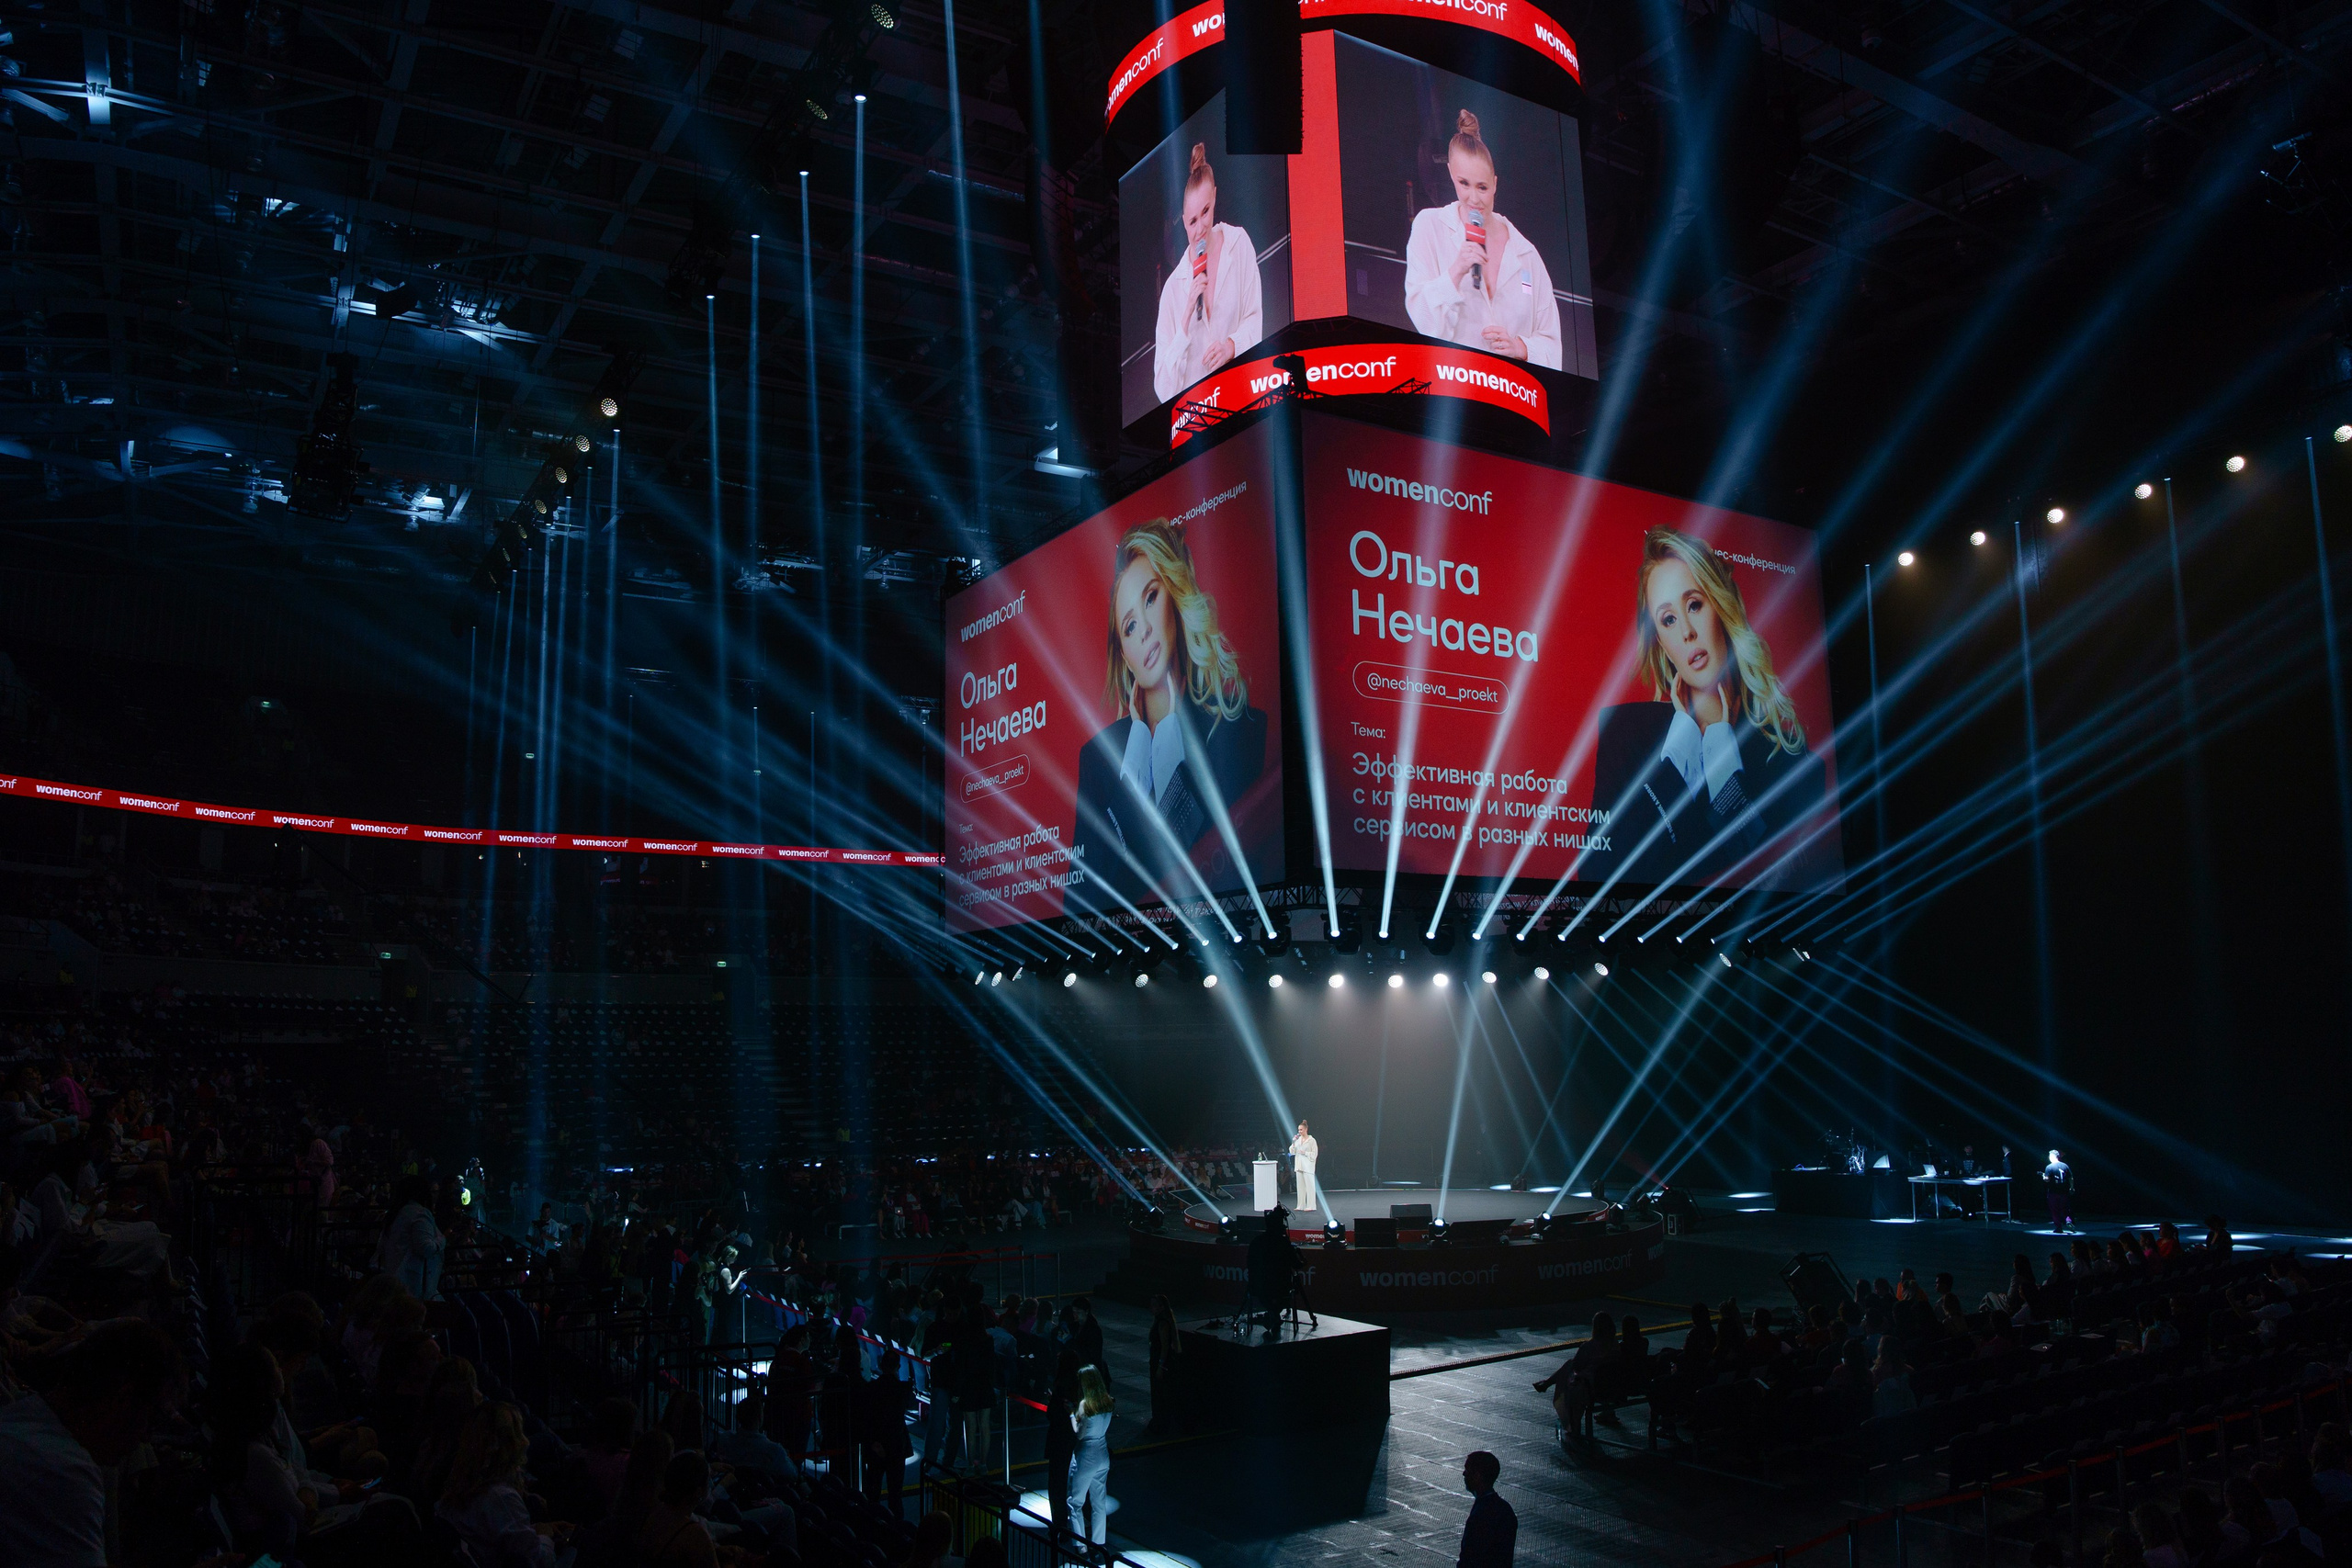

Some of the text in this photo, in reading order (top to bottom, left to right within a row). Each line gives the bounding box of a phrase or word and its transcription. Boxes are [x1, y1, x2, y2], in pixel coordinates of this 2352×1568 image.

[1534, 23, 1579, 72] women
[1105, 37, 1164, 112] omenconf
[1436, 365, 1538, 408] womenconf
[1347, 467, 1493, 515] womenconf
[1349, 530, 1479, 596] Ольга
[960, 589, 1026, 643] womenconf
[1351, 589, 1539, 662] Нечаева
[960, 662, 1017, 709] Ольга
[960, 700, 1046, 758] Нечаева
[1351, 722, 1386, 739] Тема:
[1352, 751, 1567, 795] Эффективная работа
[37, 784, 103, 801] womenconf
[119, 795, 180, 812] womenconf
[1353, 787, 1611, 825] с клиентами и клиентским
[195, 806, 256, 821] womenconf
[273, 815, 335, 829] womenconf
[351, 822, 409, 836] womenconf
[424, 829, 483, 841] womenconf
[499, 834, 558, 845] womenconf
[572, 838, 629, 849] womenconf
[643, 841, 698, 852] womenconf
[712, 845, 765, 856] womenconf
[959, 824, 1059, 864] Эффективная работа
[1353, 817, 1611, 852] сервисом в разных нишах
[778, 849, 830, 859] womenconf
[842, 852, 892, 862] womenconf
[959, 844, 1085, 885] с клиентами и клиентским
[958, 869, 1085, 909] сервисом в разных нишах
[1359, 1263, 1499, 1287] womenconf
[1538, 1248, 1633, 1280] womenconf
